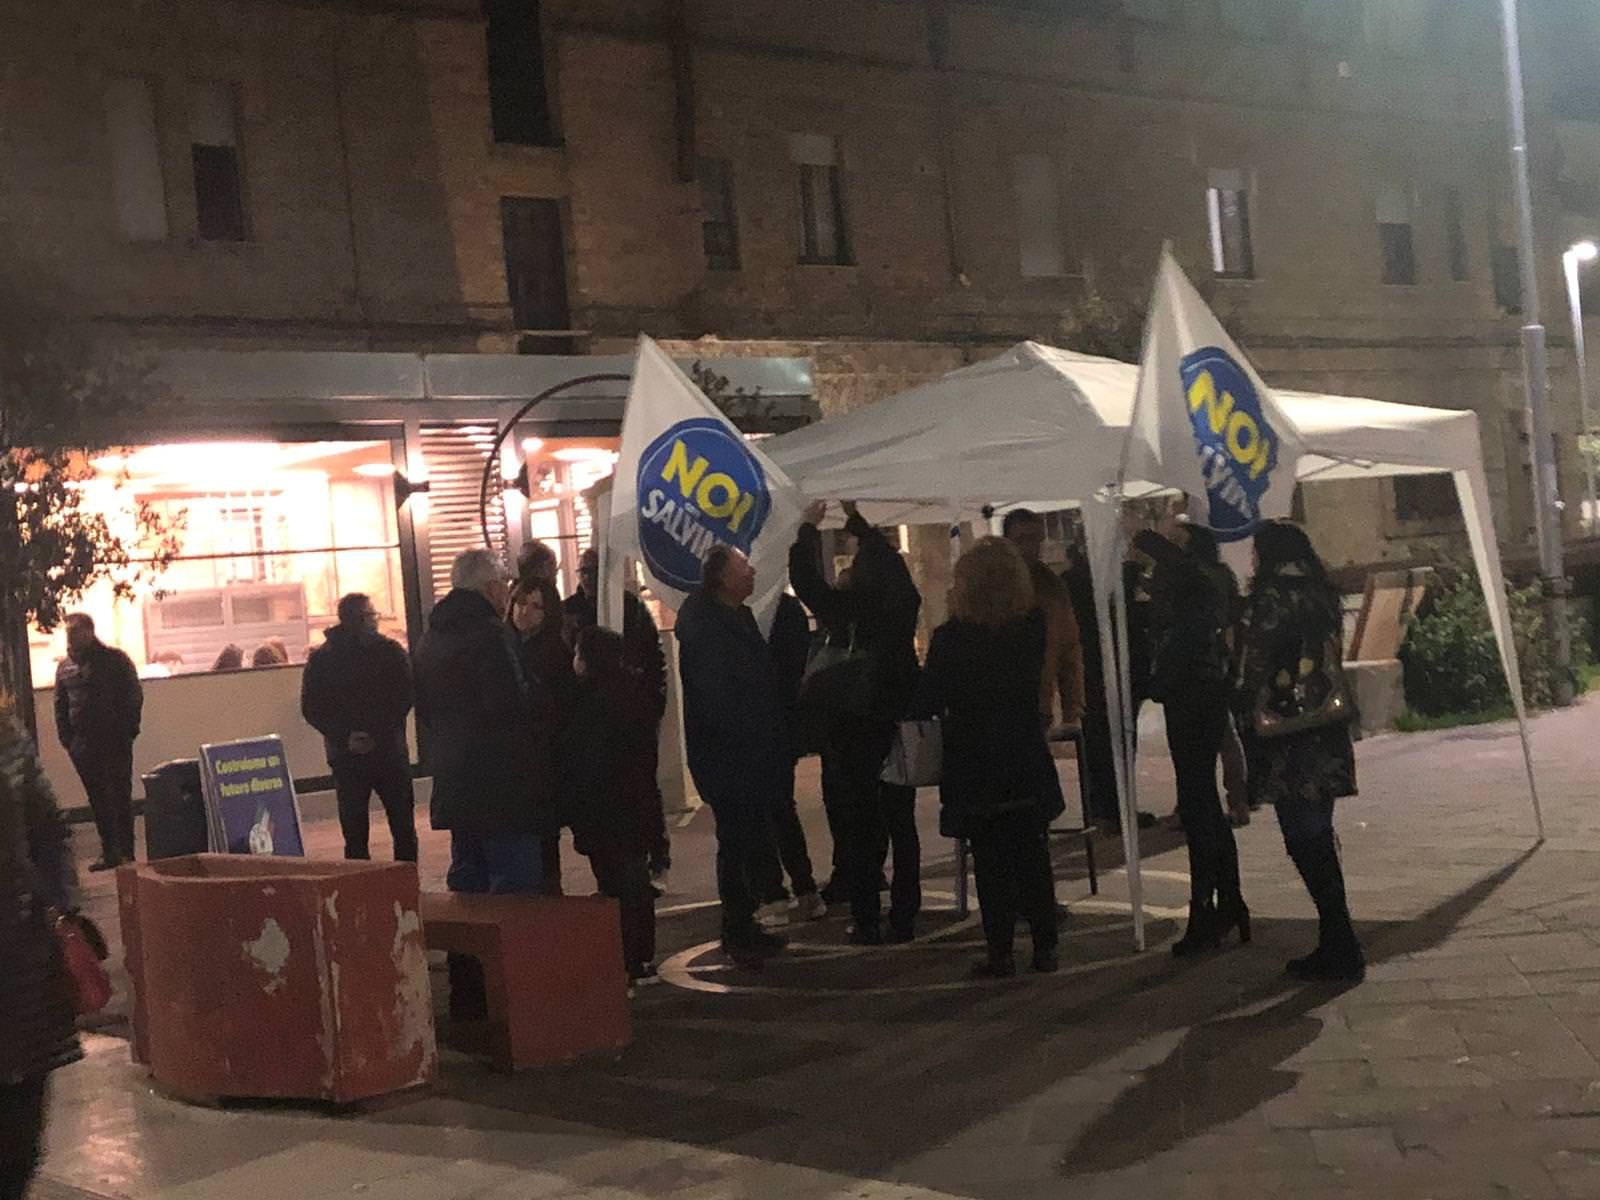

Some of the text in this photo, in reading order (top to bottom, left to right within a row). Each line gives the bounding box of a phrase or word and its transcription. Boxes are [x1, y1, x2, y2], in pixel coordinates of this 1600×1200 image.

[1188, 370, 1270, 480] NOI
[641, 488, 727, 562] SALVIN
[661, 439, 755, 533] NOI
